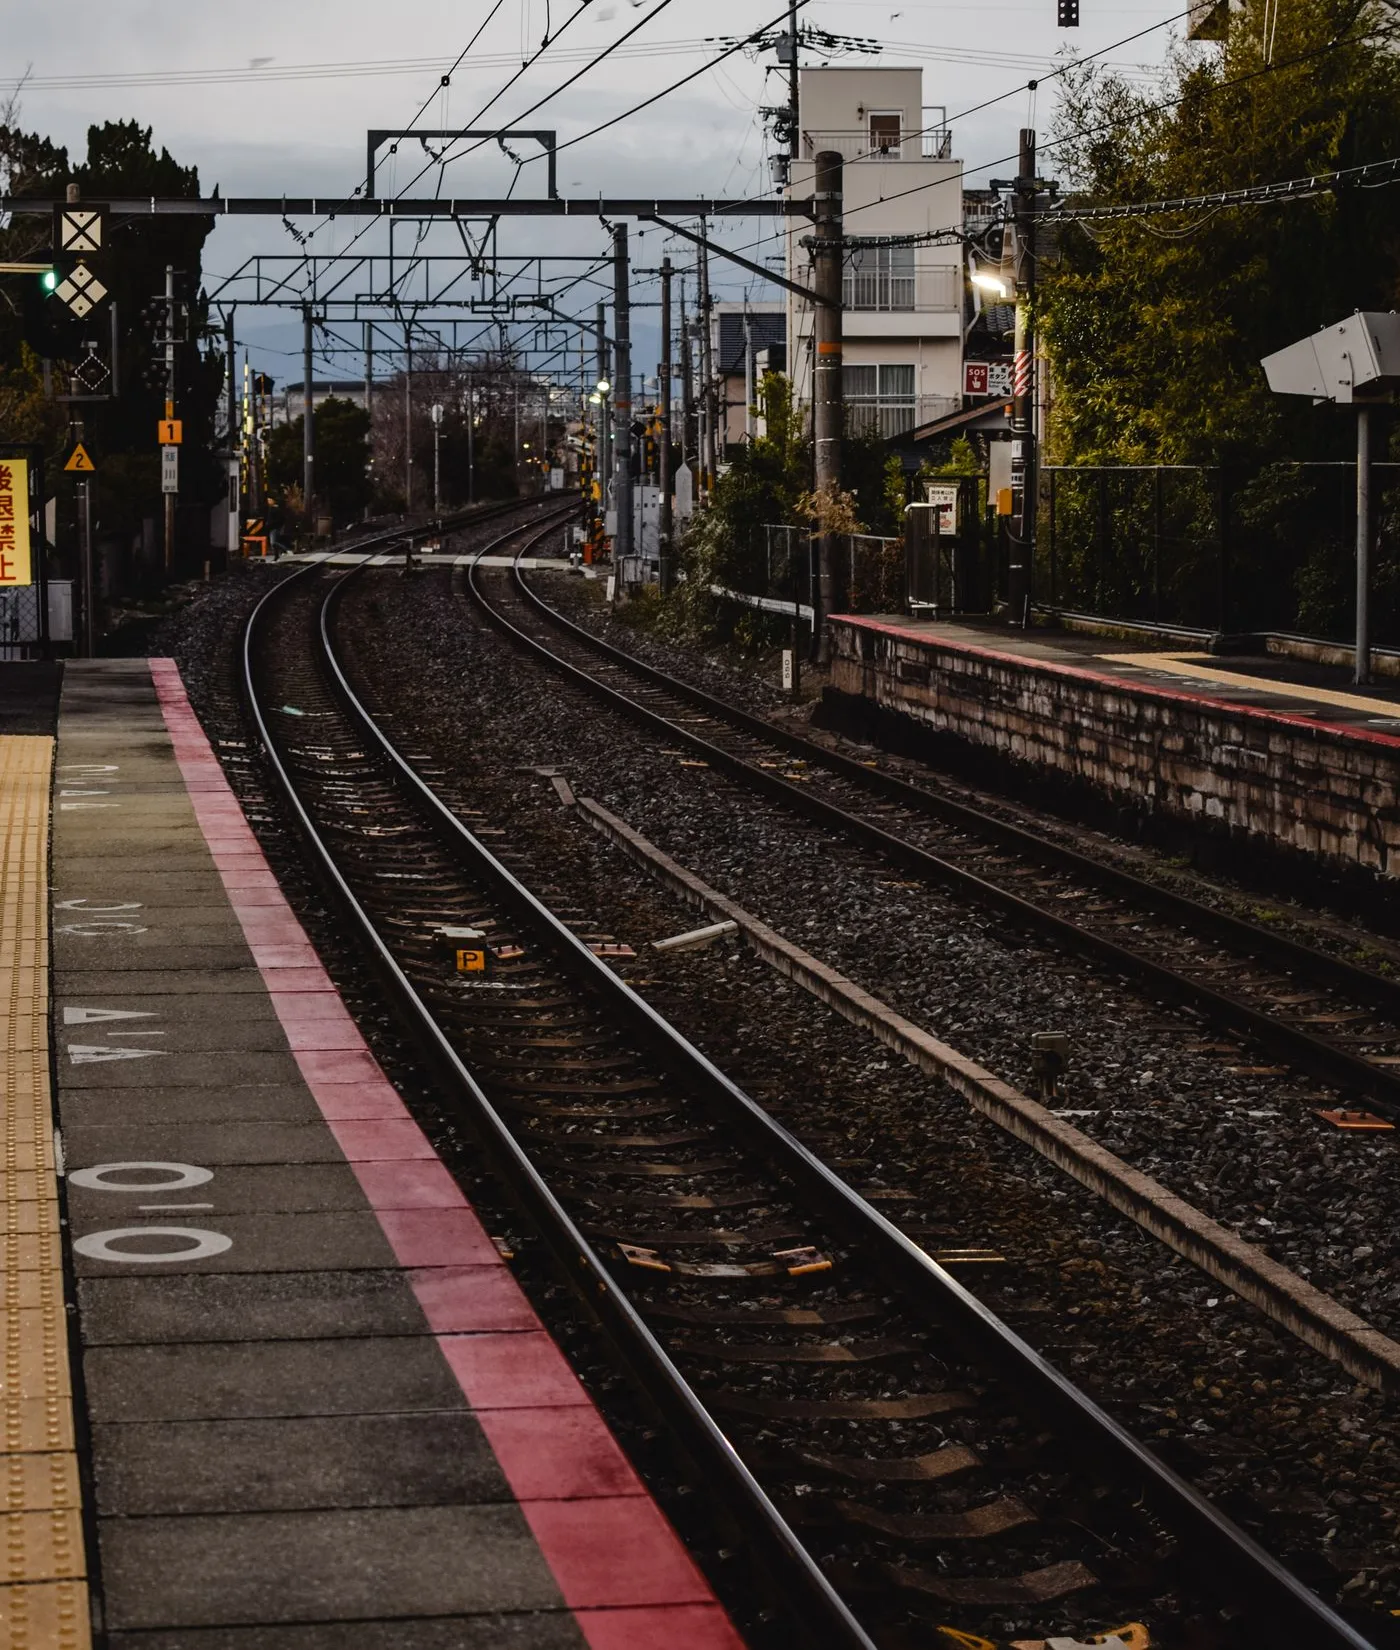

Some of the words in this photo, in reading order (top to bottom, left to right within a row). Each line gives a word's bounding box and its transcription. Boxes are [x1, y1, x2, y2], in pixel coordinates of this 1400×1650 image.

[968, 368, 986, 376] SOS
[167, 423, 173, 440] 1
[75, 453, 84, 468] 2
[463, 952, 478, 967] P
